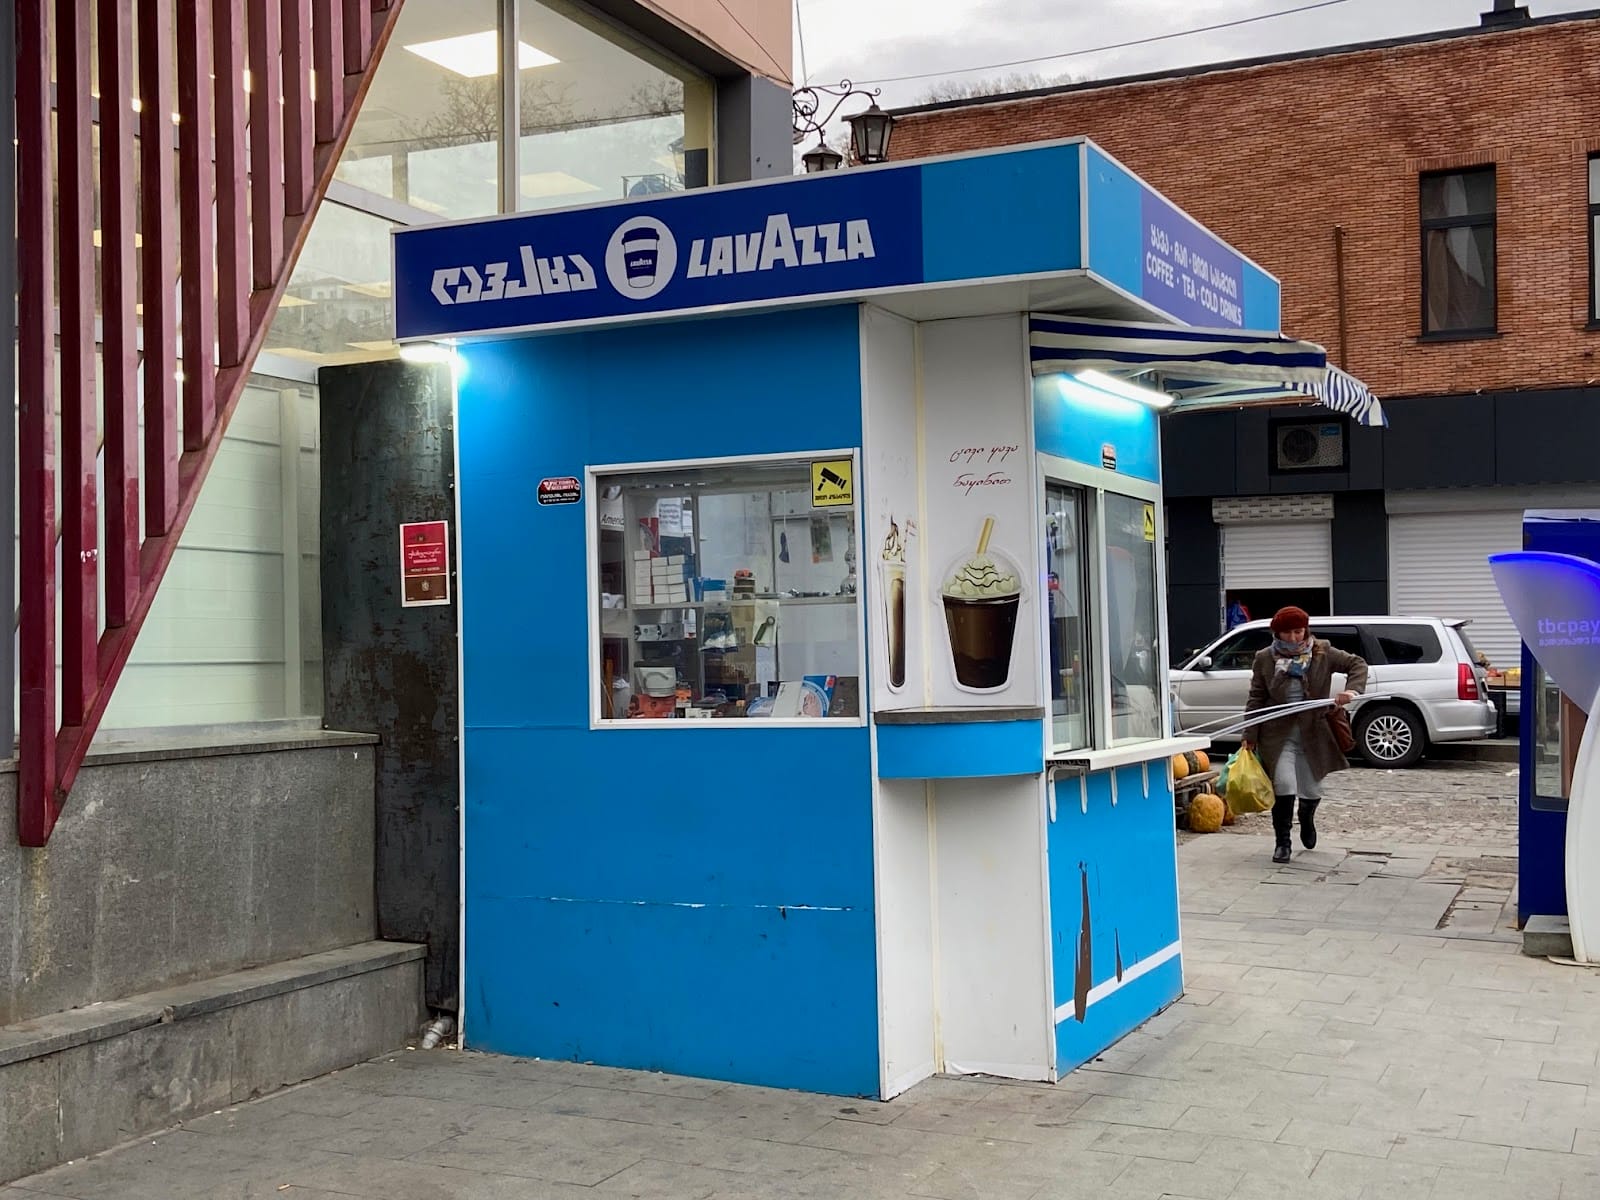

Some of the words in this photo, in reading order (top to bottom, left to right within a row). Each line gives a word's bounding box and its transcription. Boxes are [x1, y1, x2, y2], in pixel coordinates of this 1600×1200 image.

[687, 213, 876, 278] LAVAZZA
[1146, 251, 1174, 288] COFFEE
[1182, 274, 1196, 301] TEA
[1200, 285, 1218, 313] COLD
[1220, 297, 1242, 326] DRINKS
[987, 445, 1019, 463] ყავა
[1538, 618, 1600, 637] tbcpay
